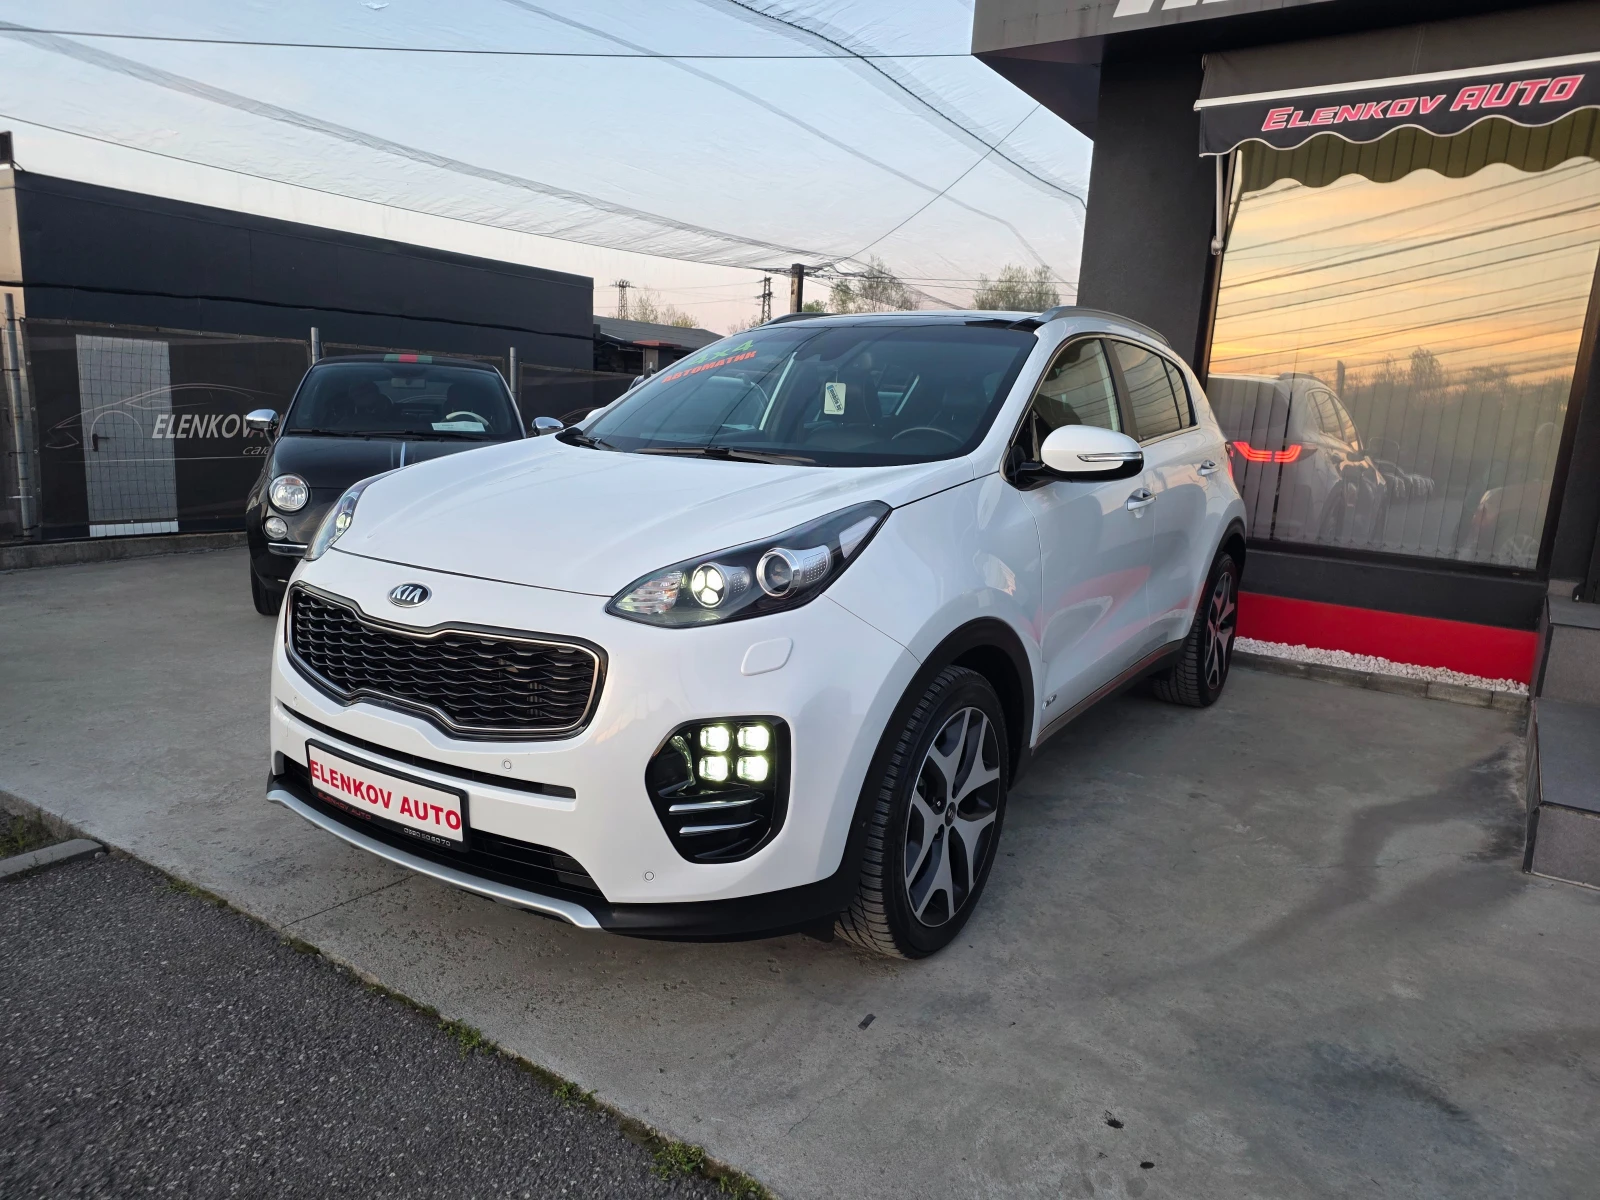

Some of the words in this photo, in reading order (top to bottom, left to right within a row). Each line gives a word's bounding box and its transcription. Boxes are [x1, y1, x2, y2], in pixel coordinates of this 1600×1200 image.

[1261, 94, 1446, 132] ELENKOV
[1449, 73, 1586, 112] AUTO
[661, 350, 758, 385] АВТОМАТИК
[391, 585, 423, 604] KIA
[309, 759, 393, 810] ELENKOV
[399, 796, 462, 831] AUTO
